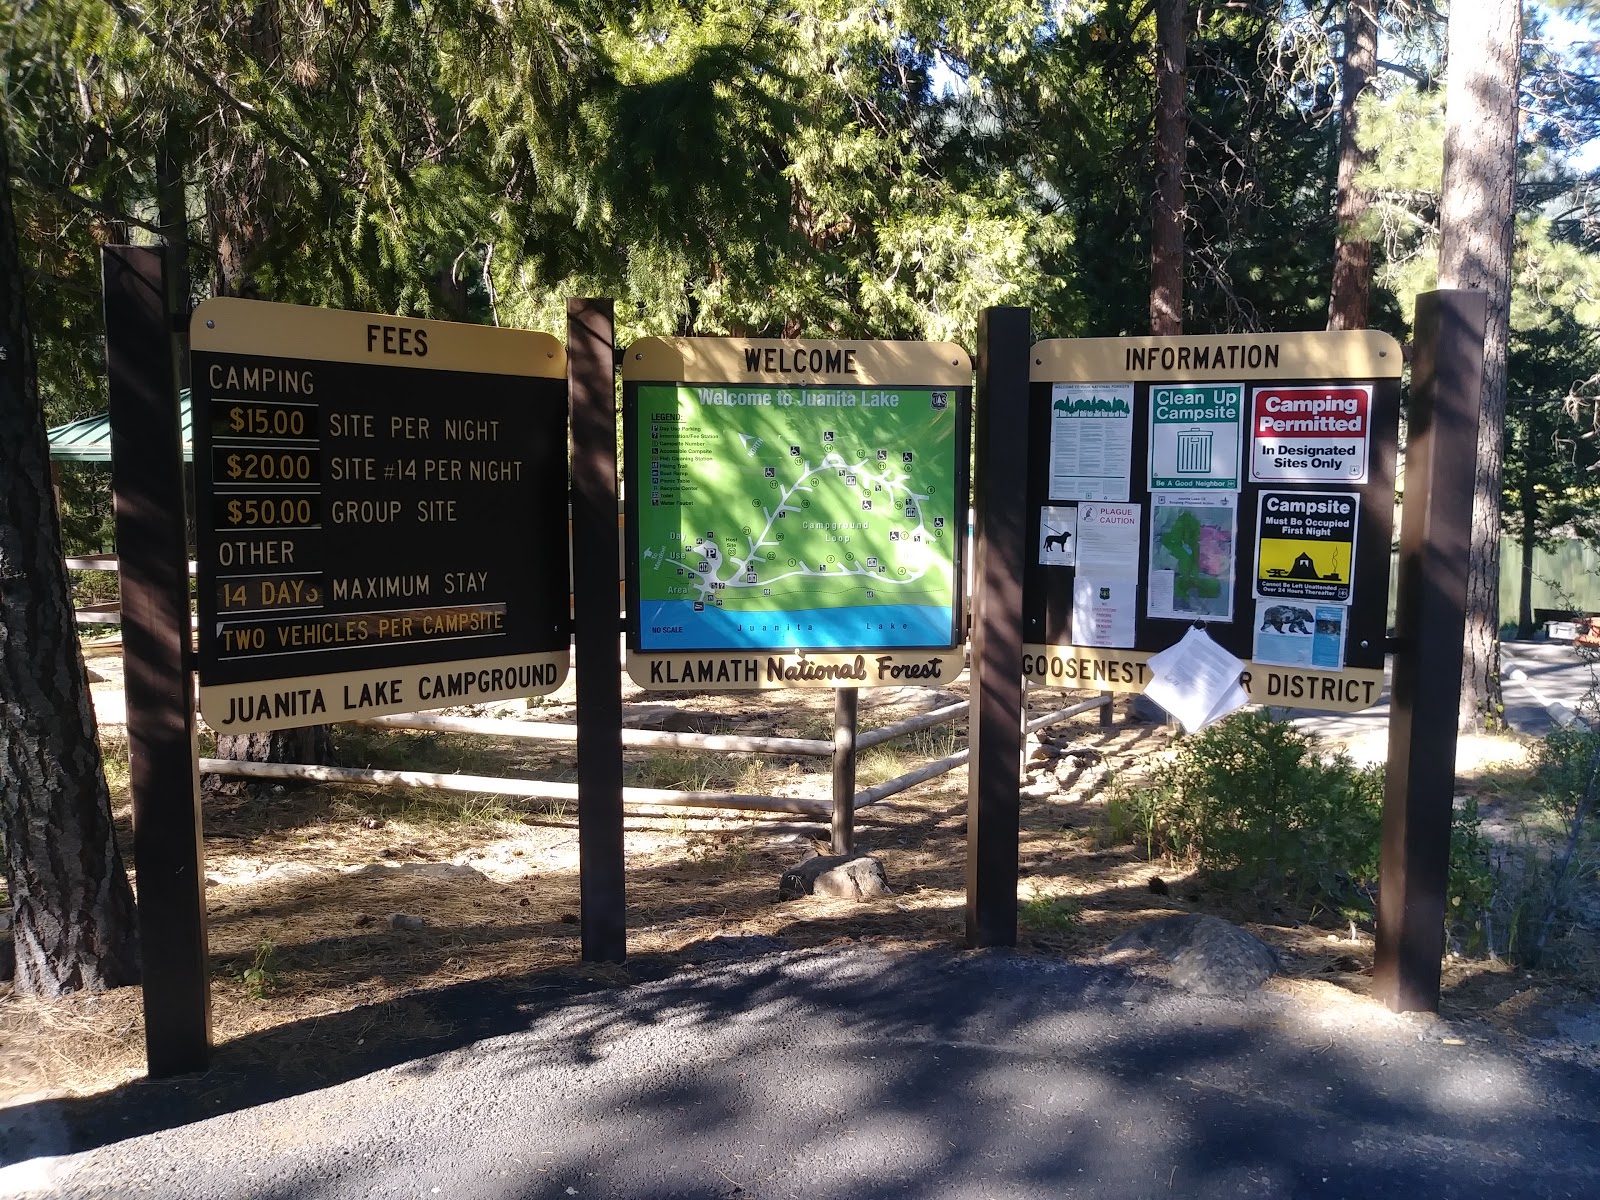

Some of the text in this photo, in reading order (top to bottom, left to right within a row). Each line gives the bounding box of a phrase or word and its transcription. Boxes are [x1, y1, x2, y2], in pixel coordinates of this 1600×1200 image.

[366, 323, 429, 357] FEES
[744, 347, 857, 375] WELCOME
[1125, 344, 1280, 371] INFORMATION
[208, 363, 315, 395] CAMPING
[698, 389, 900, 408] Welcome to Juanita Lake
[1155, 390, 1237, 408] Clean Up
[1264, 396, 1358, 416] Camping
[651, 413, 684, 421] LEGEND:
[1155, 405, 1237, 423] Campsite
[229, 407, 500, 442] $15.00 SITE PER NIGHT
[1258, 415, 1362, 433] Permitted
[747, 437, 764, 458] NORTH
[1261, 444, 1357, 459] In Designated
[226, 453, 524, 482] $20.00 SITE #14 PER NIGHT
[1272, 457, 1343, 471] Sites Only
[1195, 480, 1225, 488] Neighbor
[227, 499, 458, 525] $50.00 GROUP SITE
[1100, 508, 1132, 516] PLAGUE
[1266, 497, 1351, 516] Campsite
[802, 521, 869, 531] Campground
[1099, 517, 1135, 525] CAUTION
[1265, 516, 1350, 530] Must Be Occupied
[669, 532, 687, 542] Day
[825, 534, 851, 543] Loop
[1281, 526, 1332, 538] First Night
[218, 540, 294, 567] OTHER
[651, 552, 659, 560] To
[222, 582, 248, 608] 14
[332, 574, 431, 602] MAXIMUM
[443, 571, 489, 595] STAY
[668, 586, 687, 594] Area
[222, 610, 504, 653] TWO VEHICLES PER CAMPSITE
[737, 622, 908, 632] Juanita Lake
[650, 654, 943, 684] KLAMATH National Forest
[1022, 653, 1147, 685] GOOSENEST
[221, 662, 558, 726] JUANITA LAKE CAMPGROUND
[1267, 673, 1375, 704] DISTRICT
